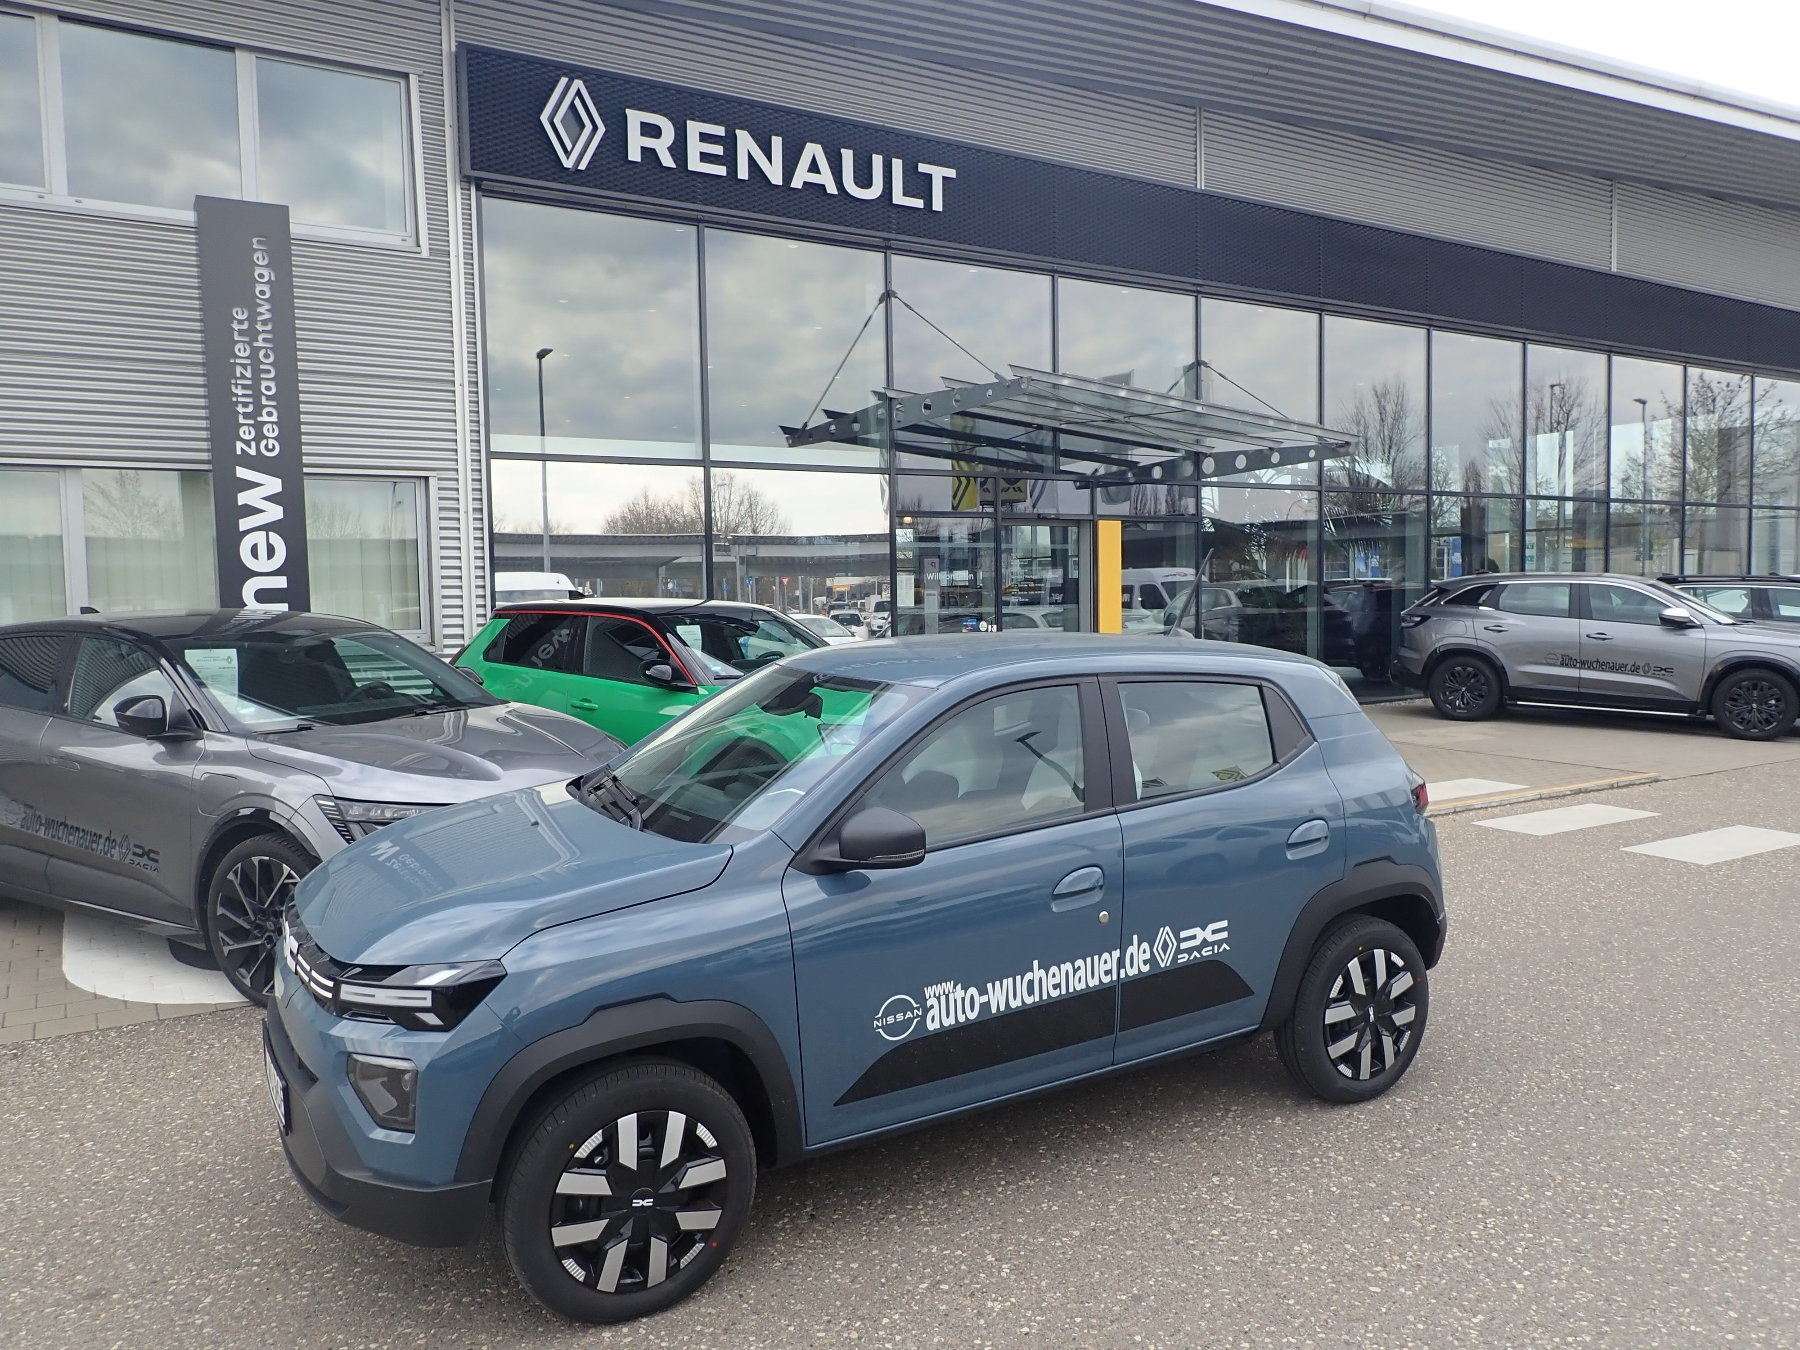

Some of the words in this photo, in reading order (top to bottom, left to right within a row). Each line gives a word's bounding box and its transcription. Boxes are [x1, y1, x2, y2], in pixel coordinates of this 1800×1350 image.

[625, 108, 957, 212] RENAULT
[230, 307, 257, 455] Zertifizierte
[252, 236, 281, 457] Gebrauchtwagen
[1559, 656, 1640, 674] auto-wuchenauer.de
[873, 1007, 922, 1028] NISSAN
[925, 933, 1151, 1031] auto-wuchenauer.de
[1177, 942, 1231, 963] DACIA
